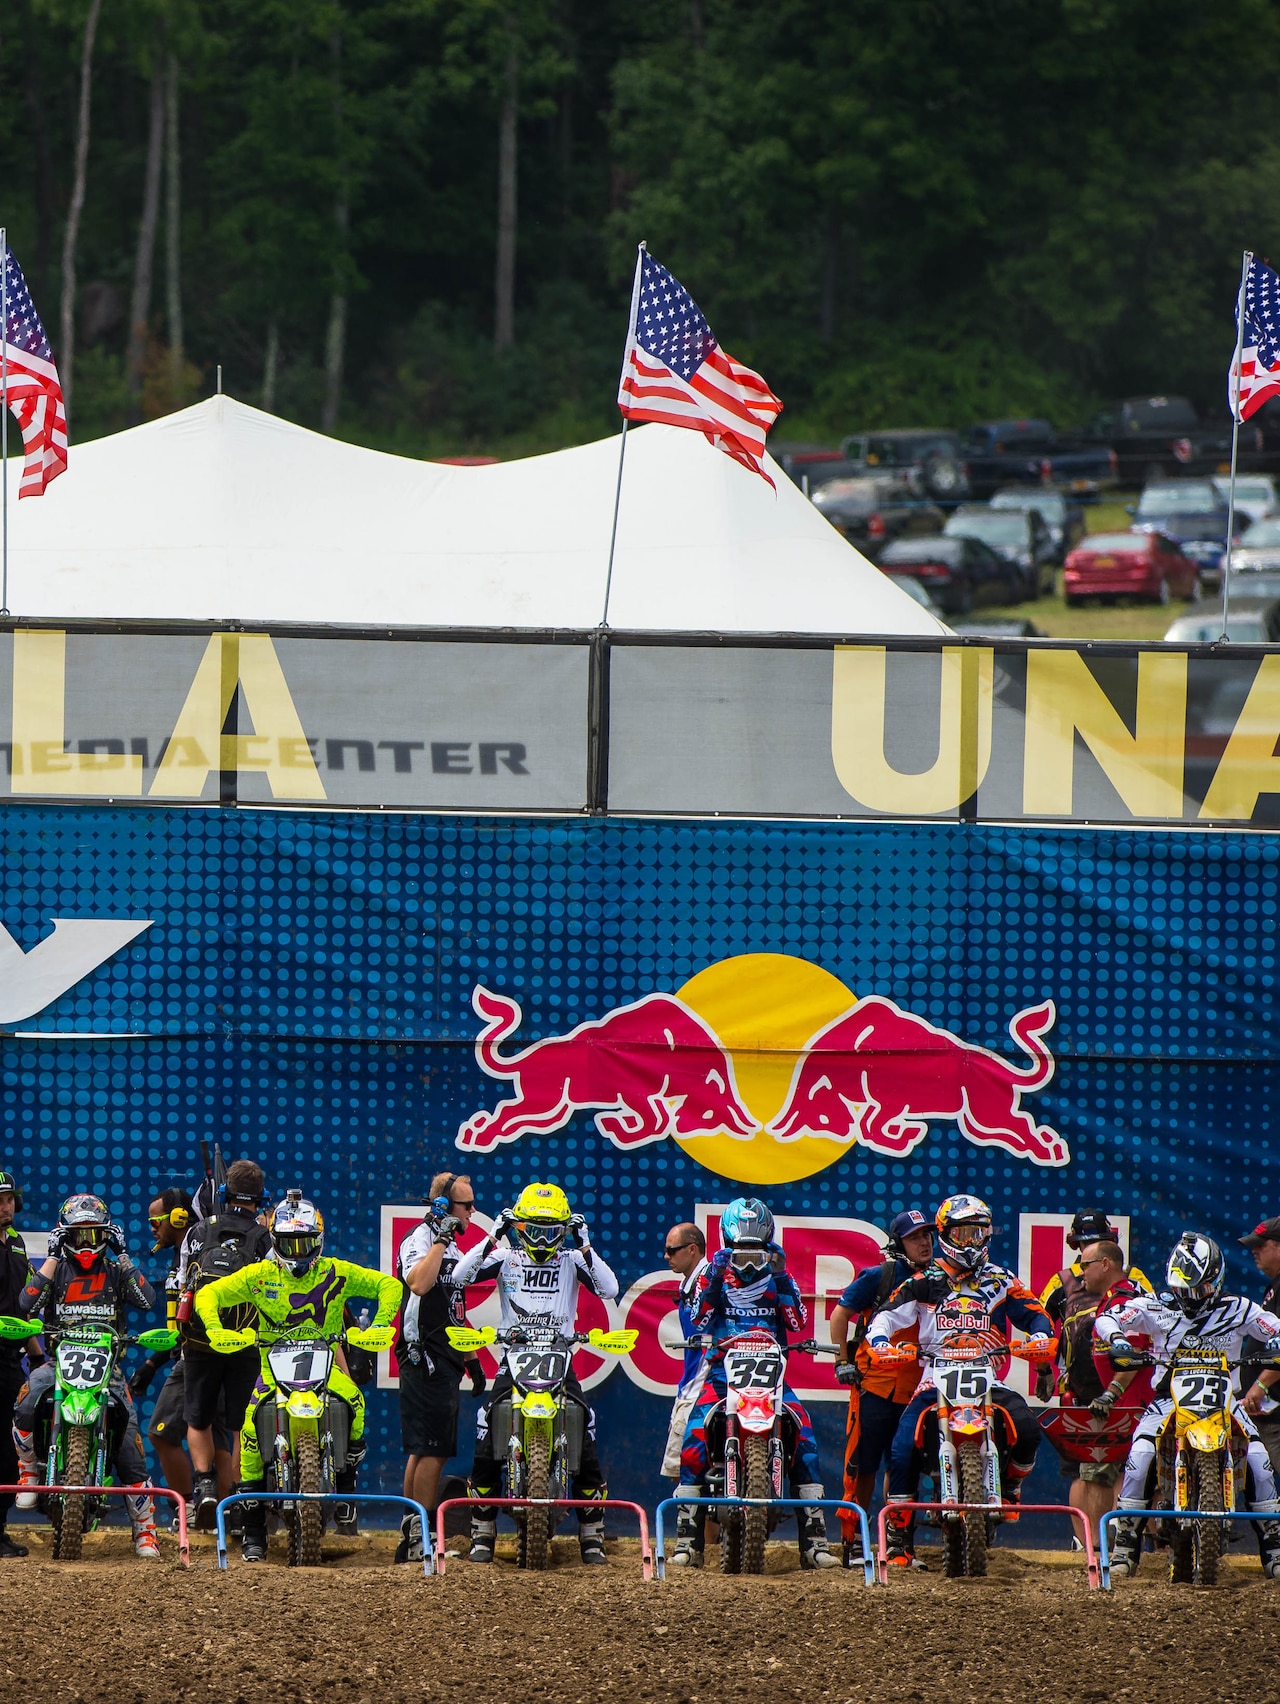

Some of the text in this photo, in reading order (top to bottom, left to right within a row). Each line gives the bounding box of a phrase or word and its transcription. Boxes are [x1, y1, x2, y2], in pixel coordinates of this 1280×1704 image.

[56, 1304, 115, 1316] Kawasaki
[515, 1313, 548, 1326] Soaring
[725, 1307, 777, 1318] HONDA
[938, 1315, 990, 1330] Red Bull
[61, 1351, 108, 1382] 33
[291, 1351, 315, 1381] 1
[516, 1353, 564, 1381] 20
[729, 1358, 779, 1389] 39
[940, 1369, 988, 1400] 15
[1178, 1377, 1228, 1407] 23
[944, 1455, 953, 1494] DLOP
